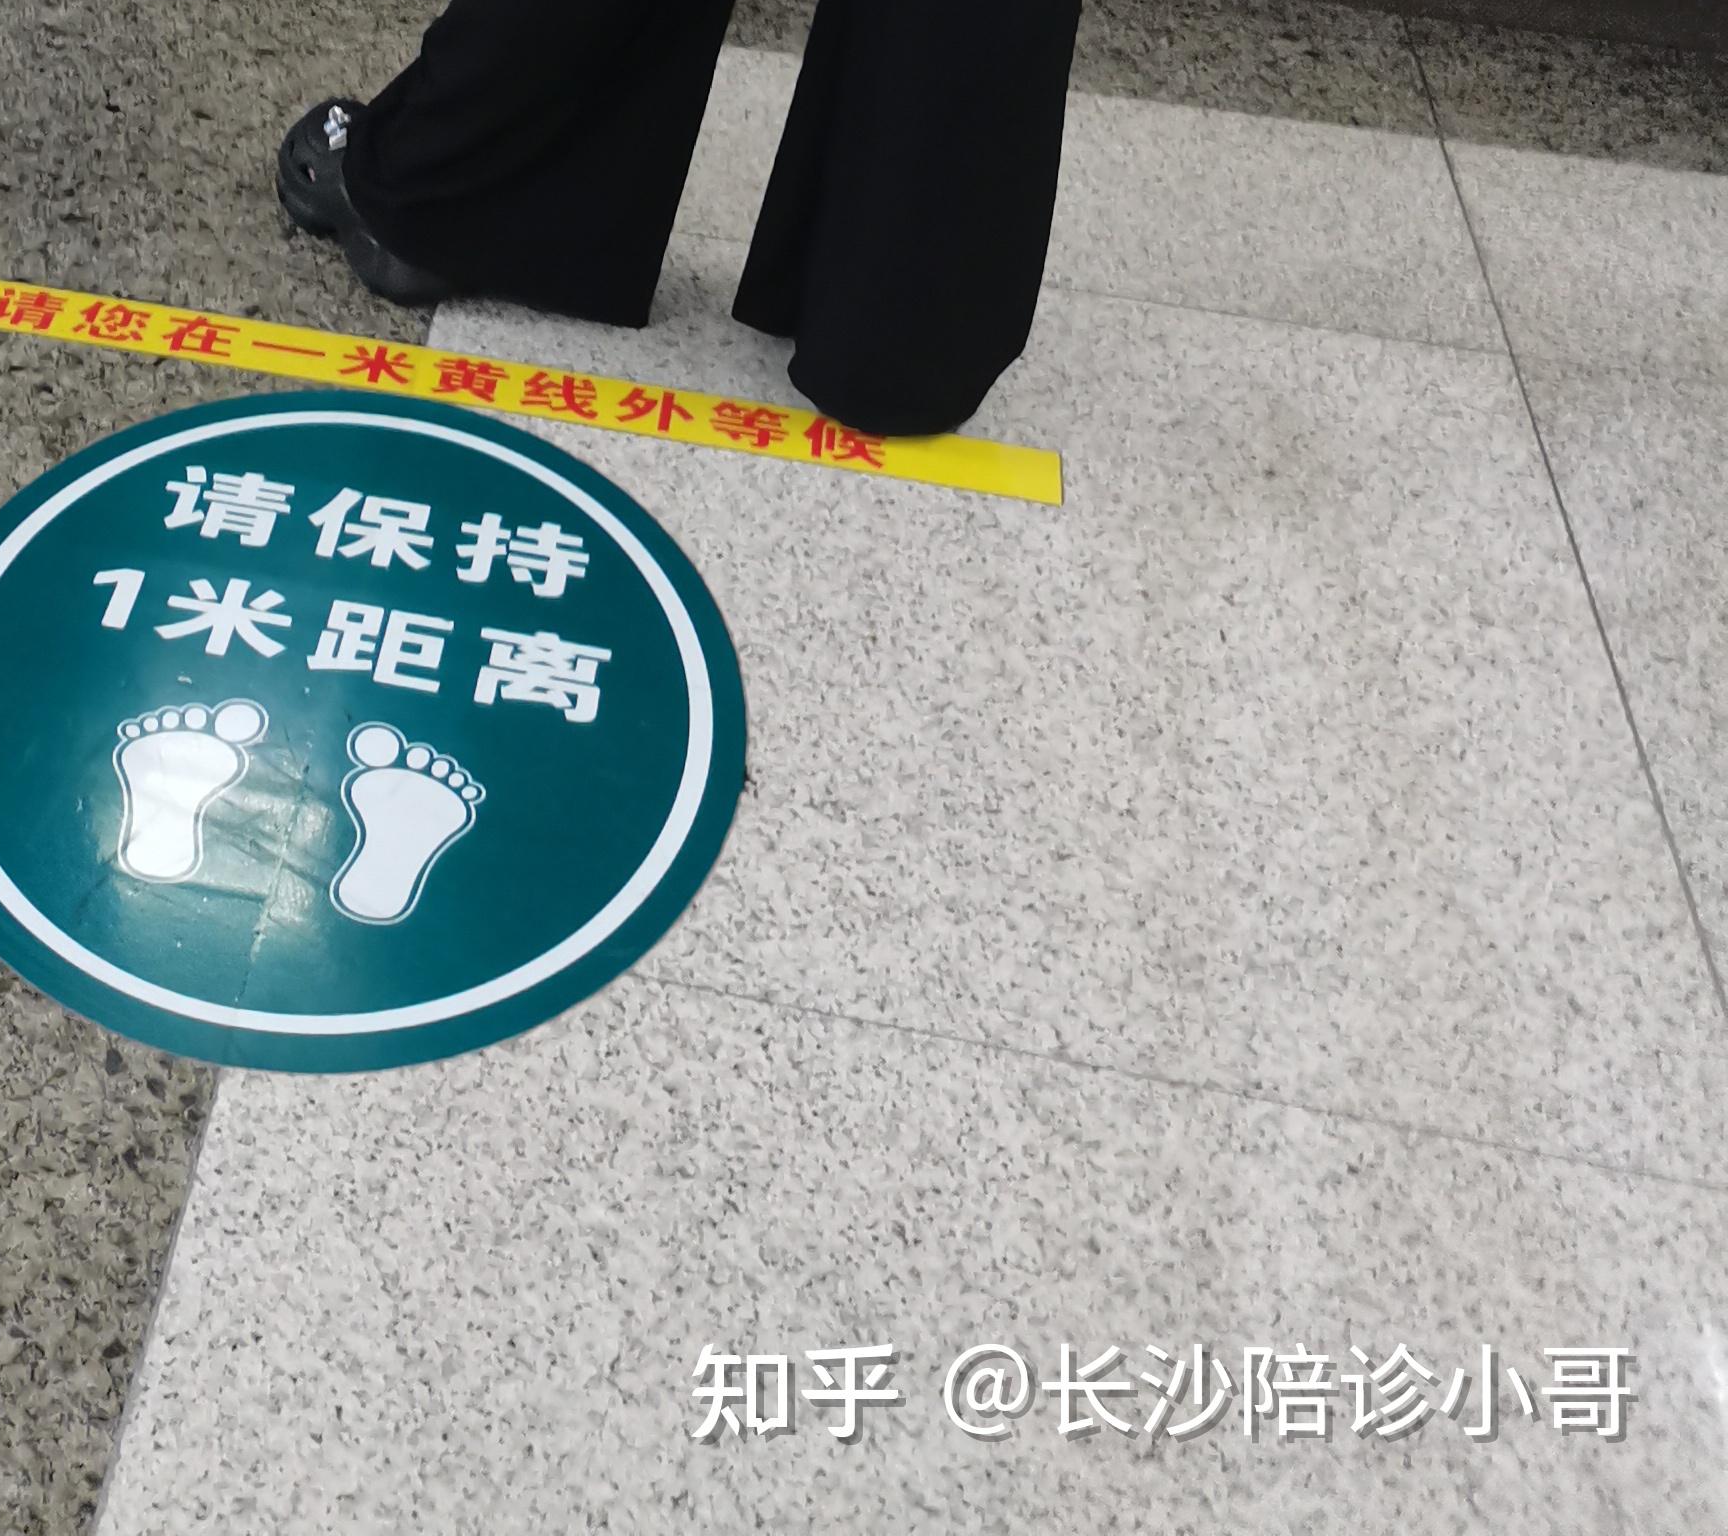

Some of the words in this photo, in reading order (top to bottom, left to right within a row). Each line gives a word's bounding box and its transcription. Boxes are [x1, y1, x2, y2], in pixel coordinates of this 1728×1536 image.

[164, 465, 591, 600] 请保持
[92, 567, 613, 724] 1米距离
